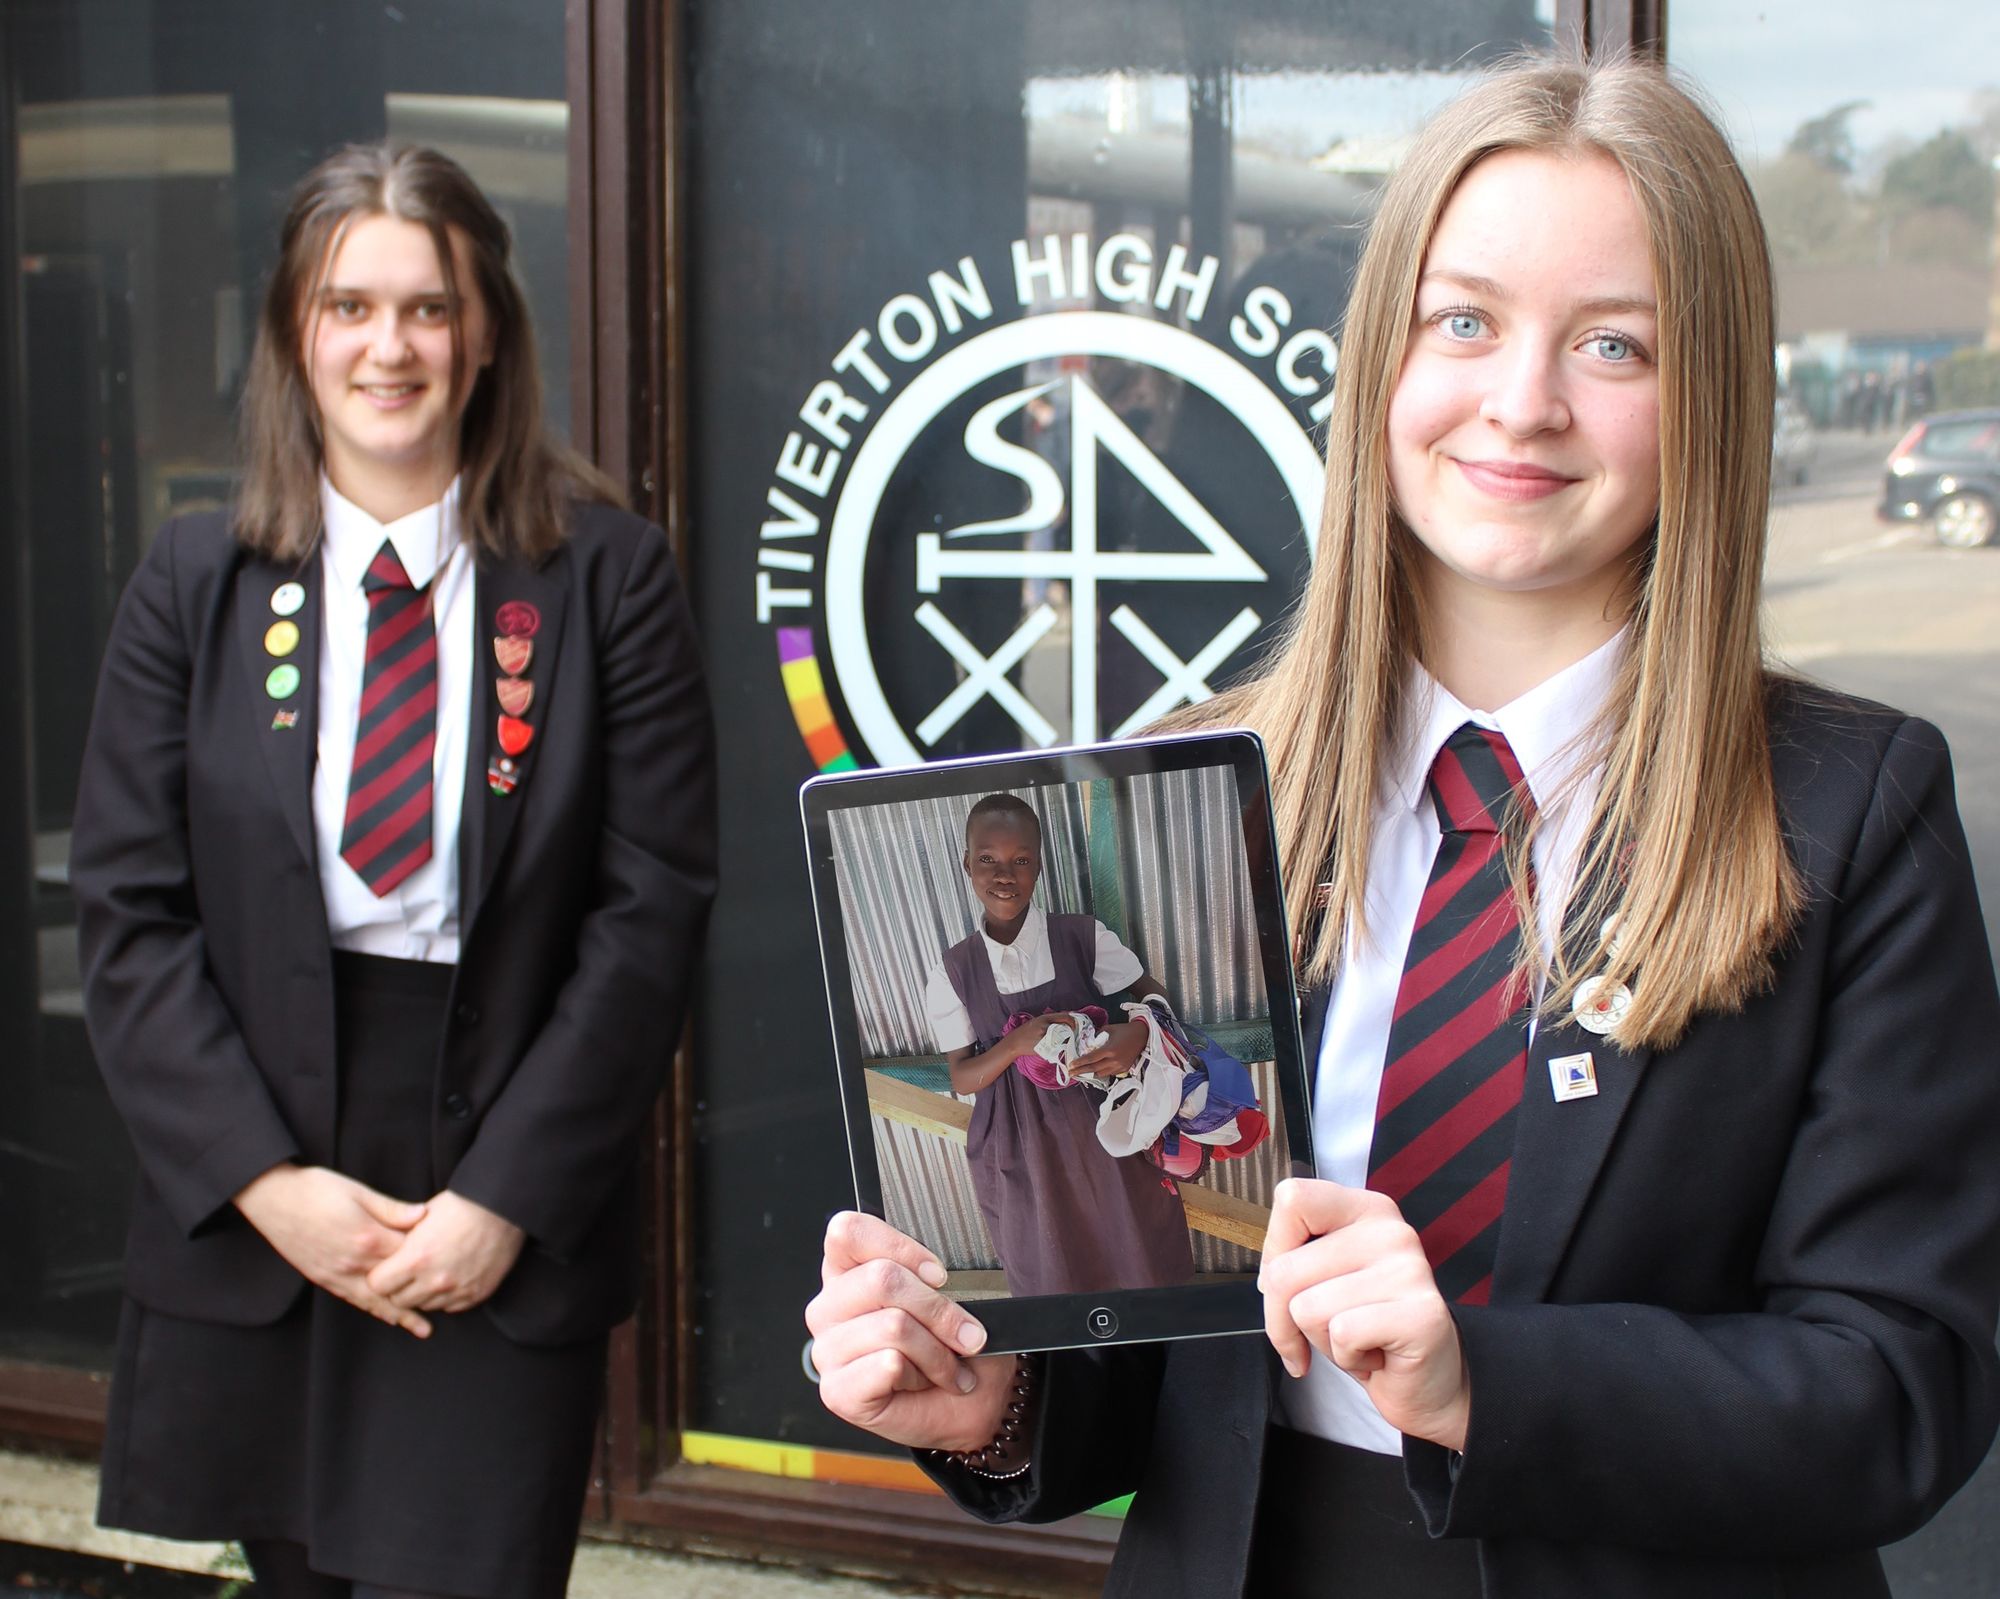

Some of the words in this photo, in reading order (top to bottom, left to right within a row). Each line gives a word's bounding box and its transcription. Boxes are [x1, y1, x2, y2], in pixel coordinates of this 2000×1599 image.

[757, 257, 993, 624] TIVERTON
[1011, 233, 1218, 321] HIGH
[1229, 286, 1340, 423] SC
